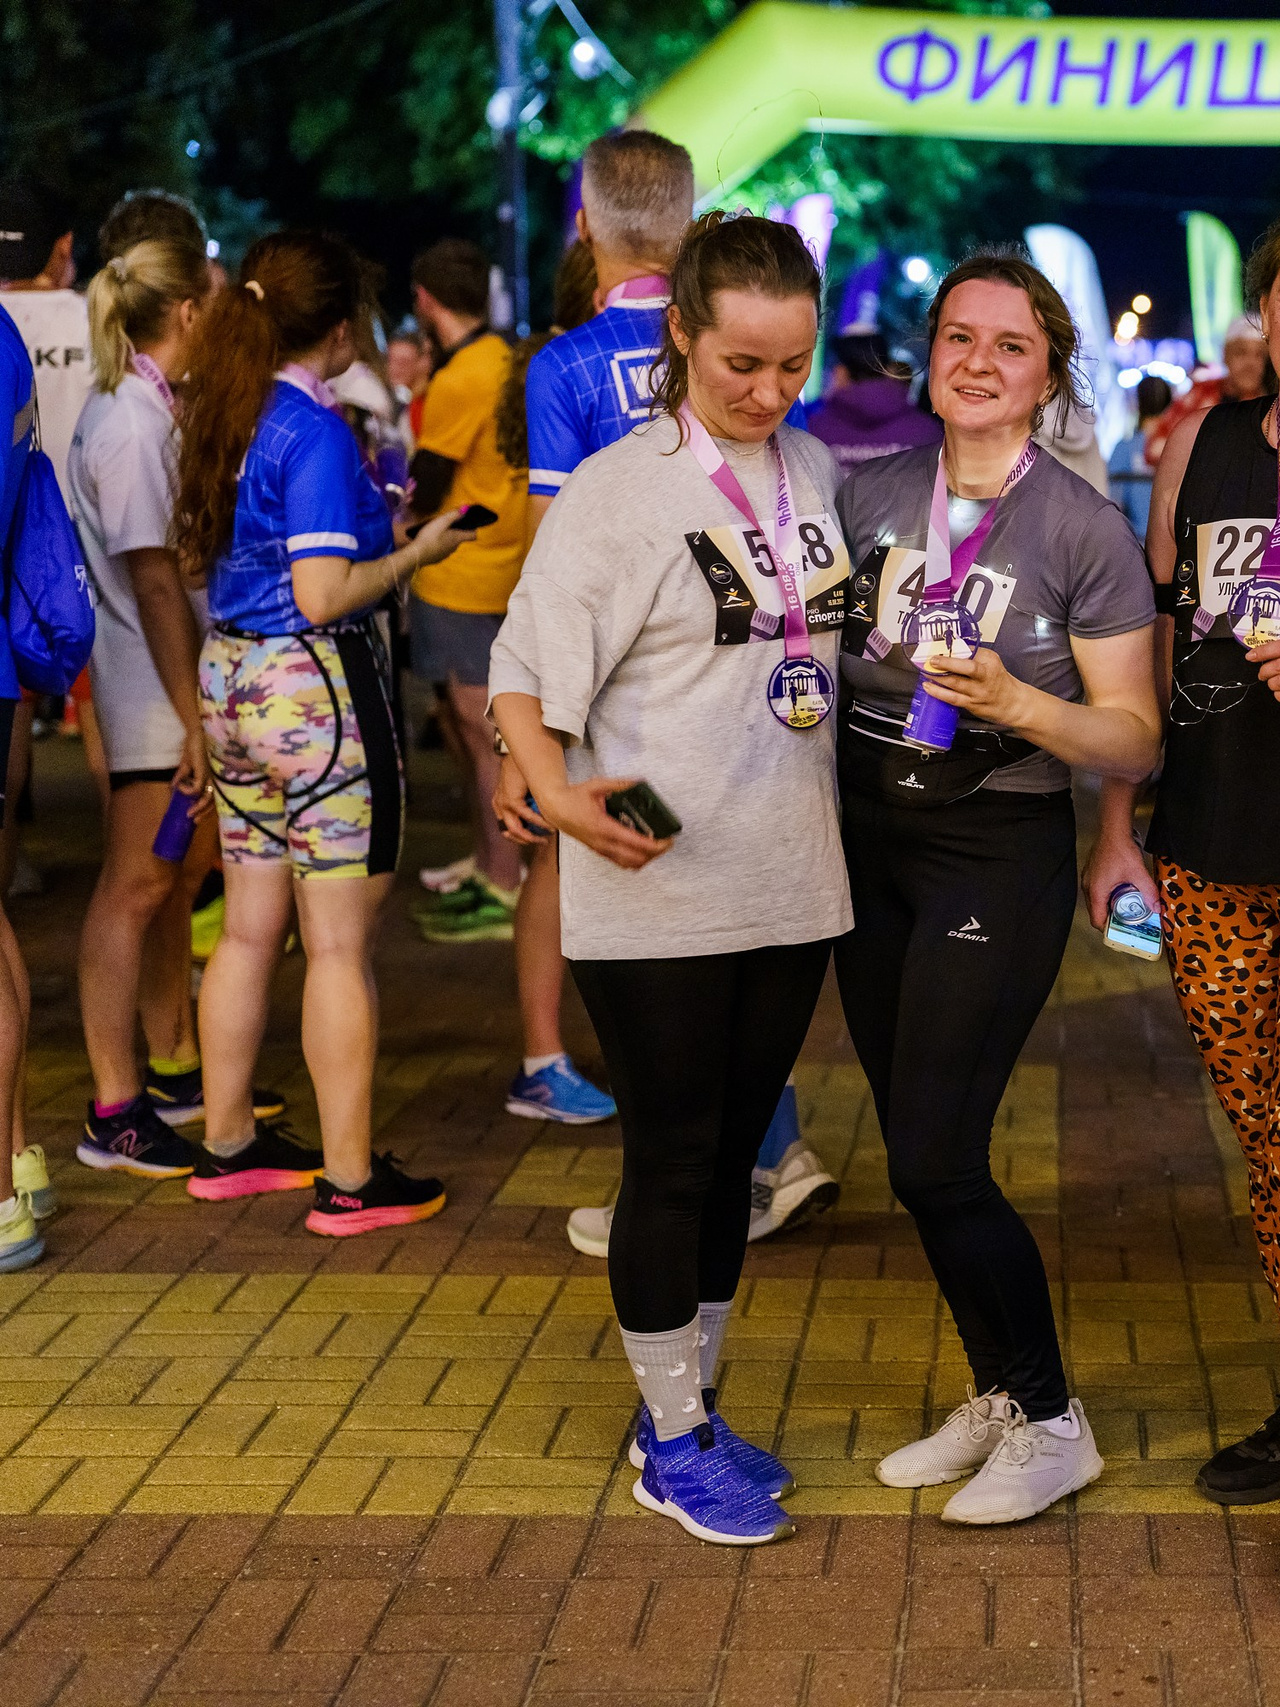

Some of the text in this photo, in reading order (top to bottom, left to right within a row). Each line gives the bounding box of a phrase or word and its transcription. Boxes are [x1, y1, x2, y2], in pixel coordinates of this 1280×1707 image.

[777, 491, 792, 527] НОЧЬ
[742, 522, 835, 578] 58
[897, 560, 993, 623] 40
[808, 612, 836, 624] СПОРТ
[837, 611, 845, 619] 40
[947, 930, 990, 942] DEMIX
